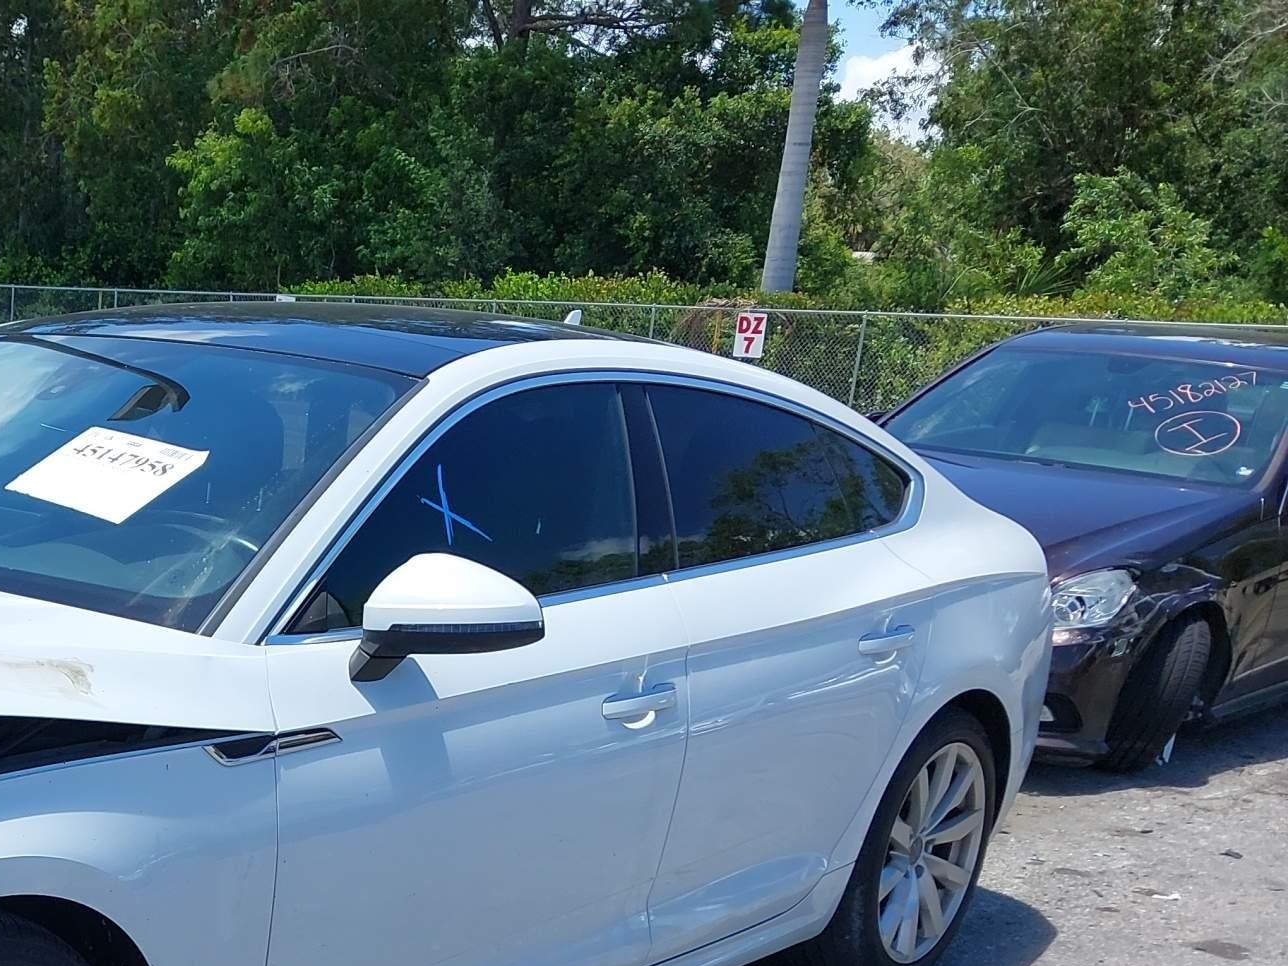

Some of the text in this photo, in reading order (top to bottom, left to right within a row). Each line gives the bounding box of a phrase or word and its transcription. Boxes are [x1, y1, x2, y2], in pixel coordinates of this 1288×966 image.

[737, 316, 765, 335] DZ
[743, 336, 755, 354] 7
[1128, 371, 1257, 414] 45182127
[73, 443, 175, 477] 45147958
